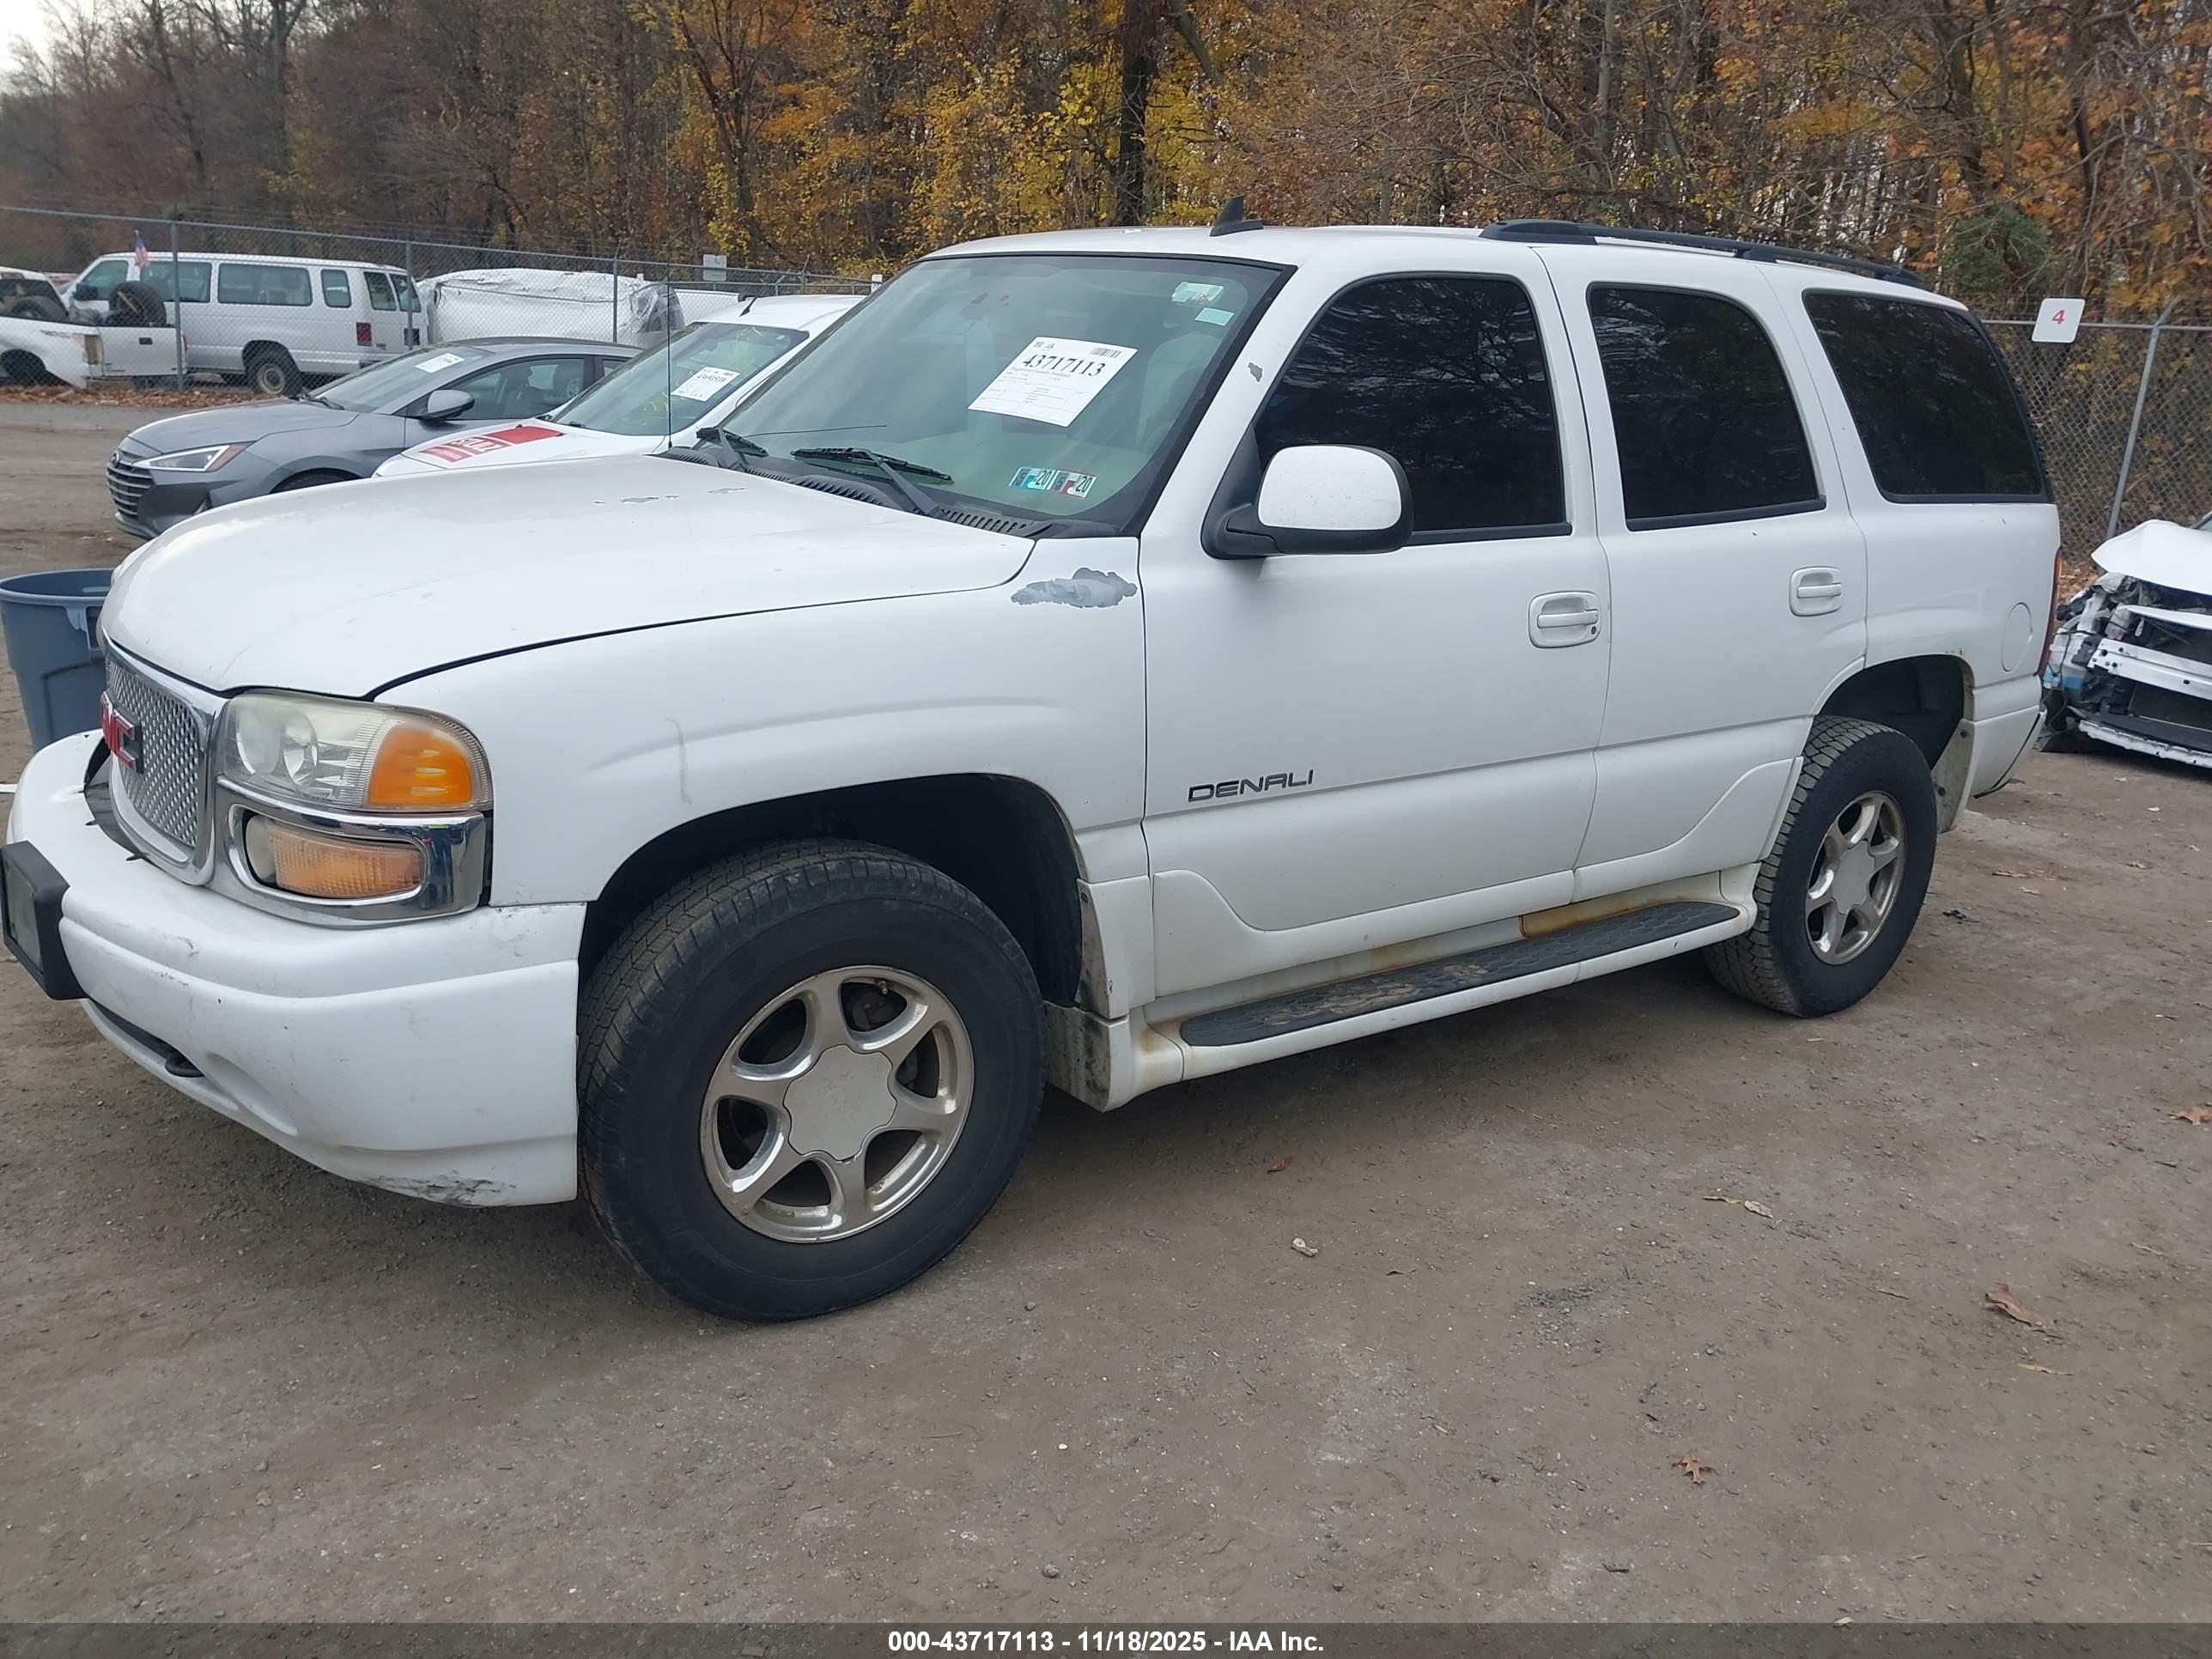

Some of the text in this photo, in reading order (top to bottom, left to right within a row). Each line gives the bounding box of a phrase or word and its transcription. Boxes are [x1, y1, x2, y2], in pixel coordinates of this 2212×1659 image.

[2052, 309, 2066, 325] 4
[1023, 354, 1106, 377] 43717113
[1035, 470, 1053, 487] 20
[1075, 475, 1093, 494] 20
[1188, 769, 1314, 803] DENALI
